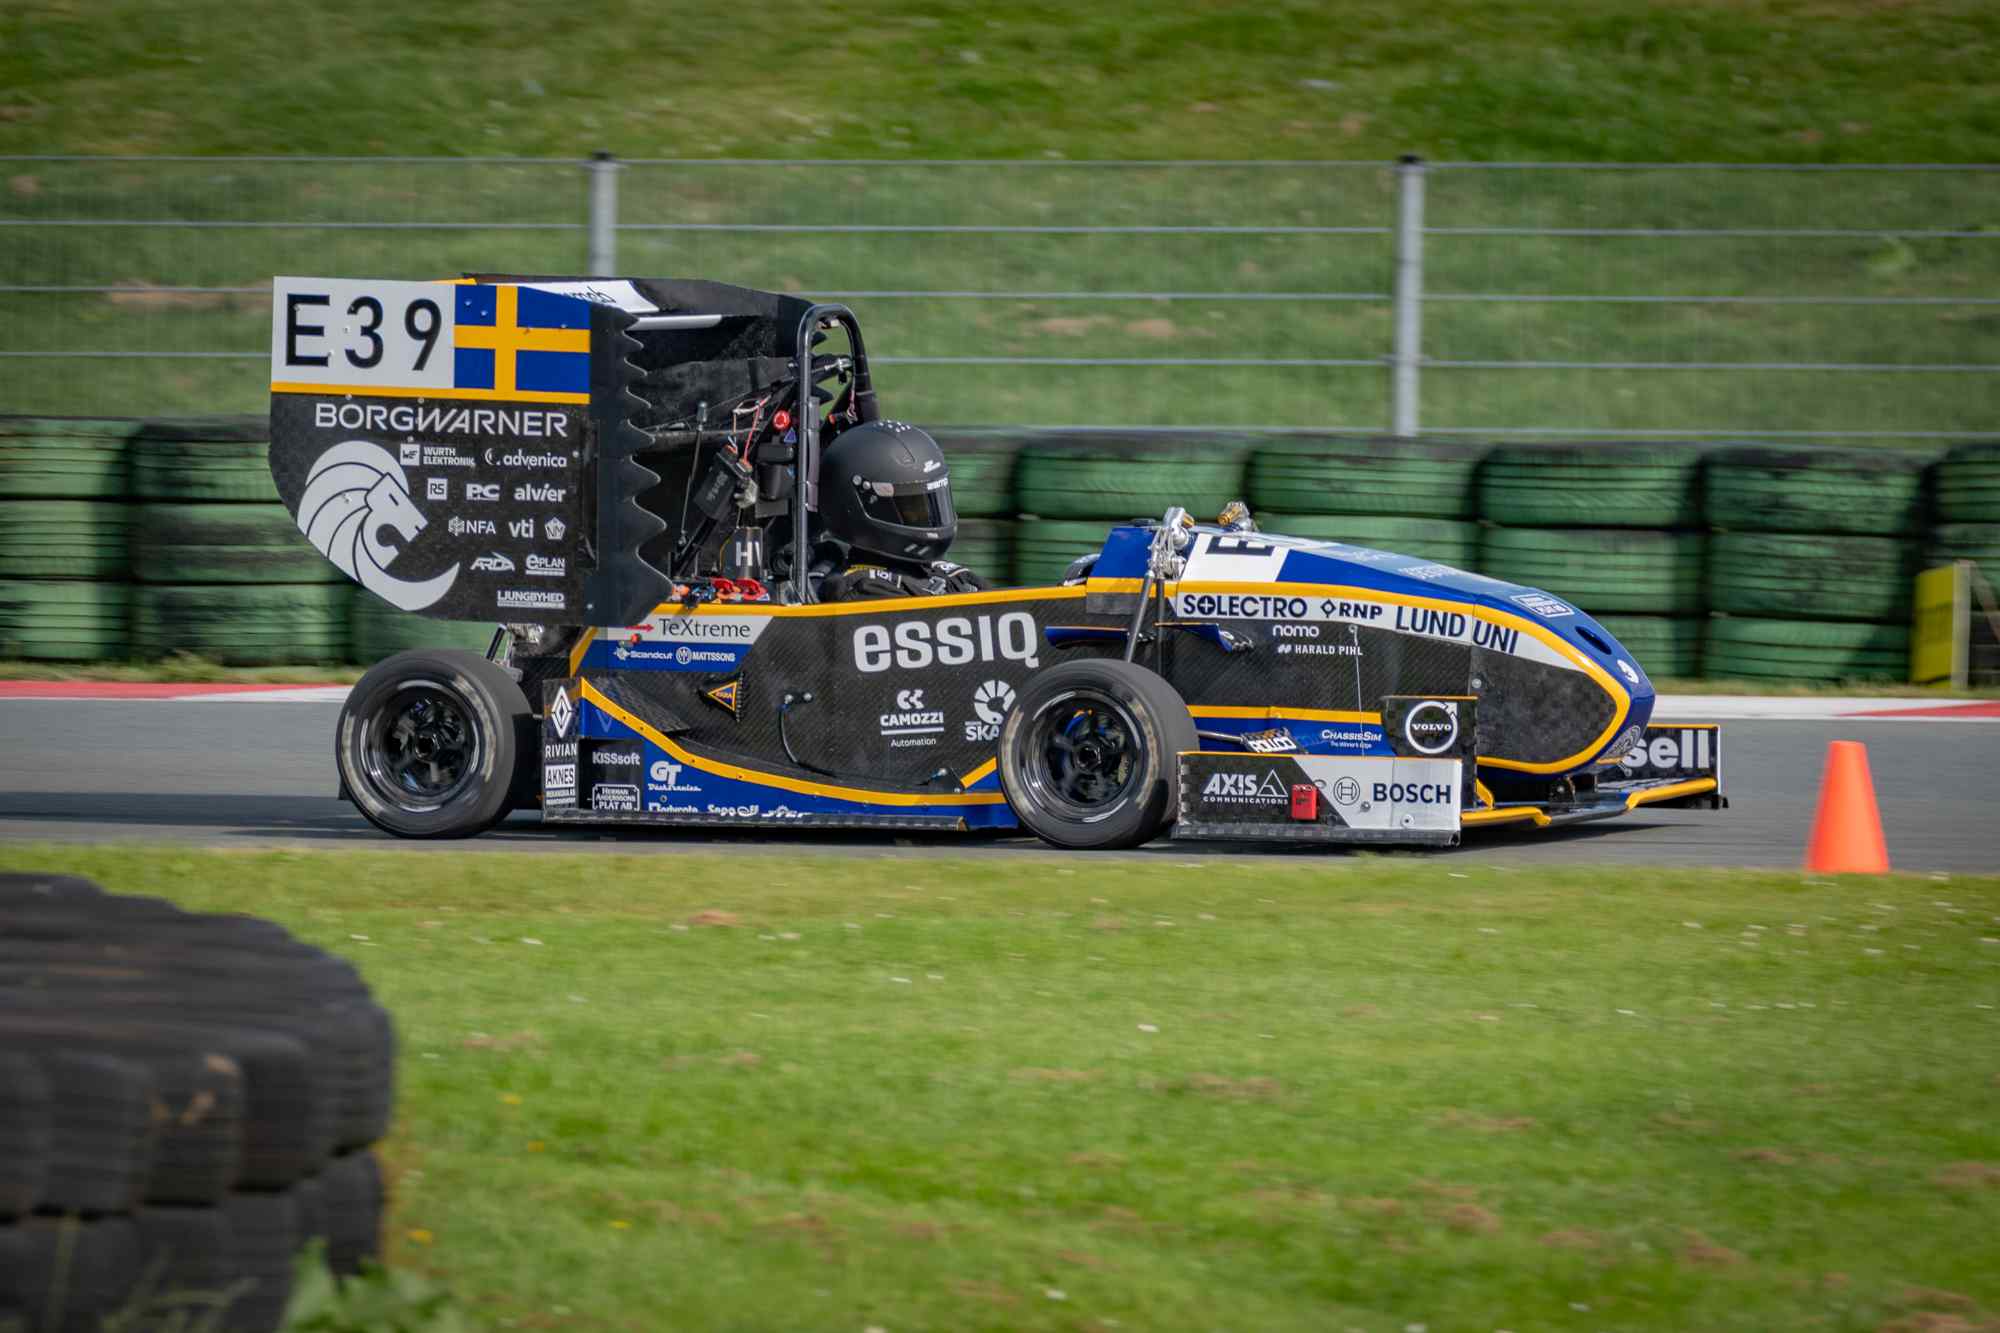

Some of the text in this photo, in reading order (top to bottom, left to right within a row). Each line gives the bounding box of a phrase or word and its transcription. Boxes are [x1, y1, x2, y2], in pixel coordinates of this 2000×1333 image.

[284, 293, 442, 371] E39
[314, 402, 568, 438] BORGWARNER
[503, 449, 567, 469] advenica
[514, 483, 567, 502] alvier
[466, 520, 496, 535] NFA
[508, 518, 534, 538] vti
[497, 590, 564, 602] LJUNGBYHED
[1183, 594, 1308, 618] SOLECTRO
[1339, 603, 1383, 620] RNP
[658, 618, 751, 638] TeXtreme
[1272, 624, 1320, 638] nomo
[1395, 606, 1520, 654] LUND UNI
[1295, 644, 1335, 655] HARALD
[880, 712, 944, 727] CAMOZZI
[1411, 723, 1452, 732] VOLVO
[545, 743, 577, 759] RIVIAN
[890, 737, 936, 748] Automation
[592, 751, 640, 766] KISSsoft
[650, 760, 682, 787] GT
[1203, 773, 1258, 796] AXIS
[1372, 782, 1452, 804] BOSCH
[1202, 796, 1288, 805] COMMUNICATIONS
